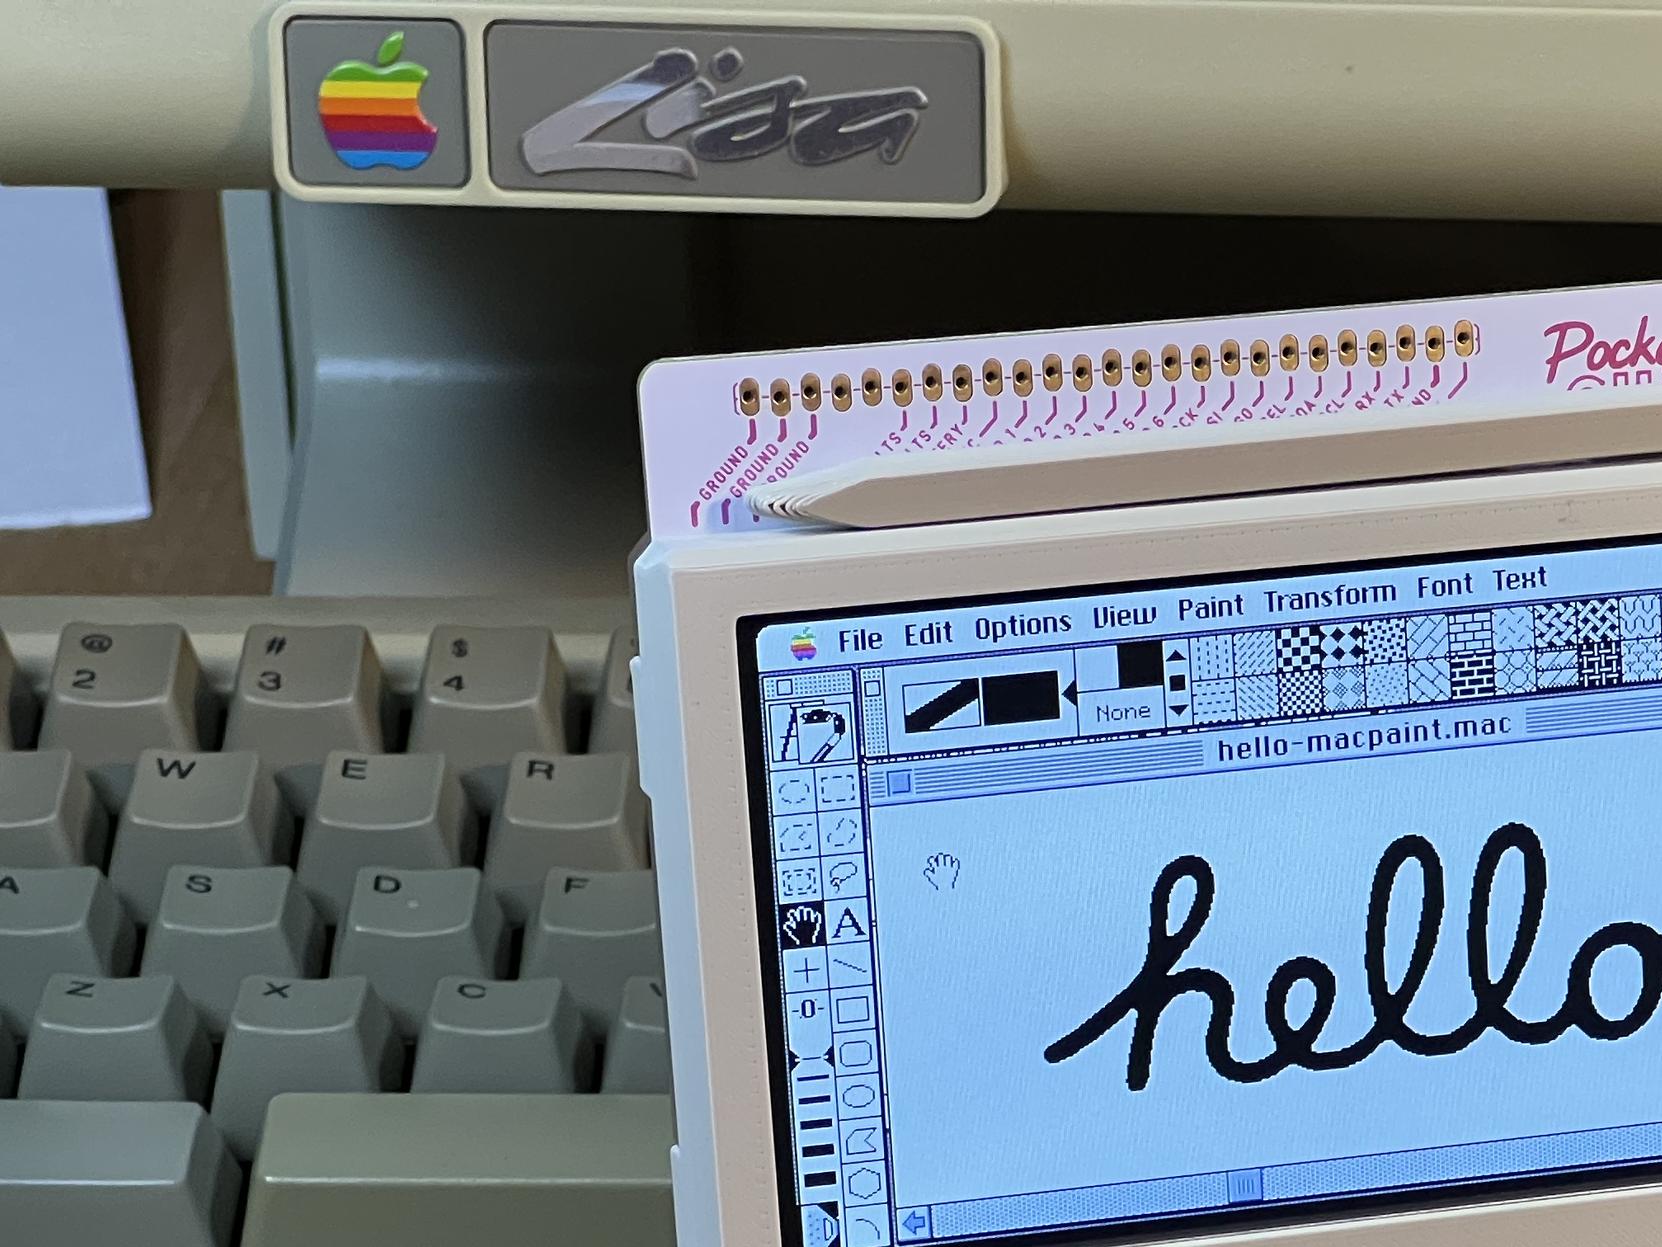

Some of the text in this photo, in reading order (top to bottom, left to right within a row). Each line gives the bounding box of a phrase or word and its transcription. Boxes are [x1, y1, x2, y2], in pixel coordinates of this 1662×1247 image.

[520, 47, 929, 182] Lisa
[699, 445, 748, 500] GROUND
[730, 443, 779, 498] GROUND
[839, 566, 1548, 652] File Edit Options View Paint Transform Font Text
[71, 669, 97, 691] 2
[257, 671, 283, 692] 3
[442, 674, 466, 693] 4
[1096, 702, 1151, 723] None
[1217, 711, 1512, 763] hello-macpaint.mac
[157, 758, 196, 780] W
[341, 758, 367, 779] E
[526, 759, 555, 780] R
[186, 874, 213, 895] S
[373, 874, 401, 894] D
[564, 875, 590, 895] F
[65, 980, 96, 998] Z
[263, 981, 292, 998] X
[457, 982, 487, 1000] C
